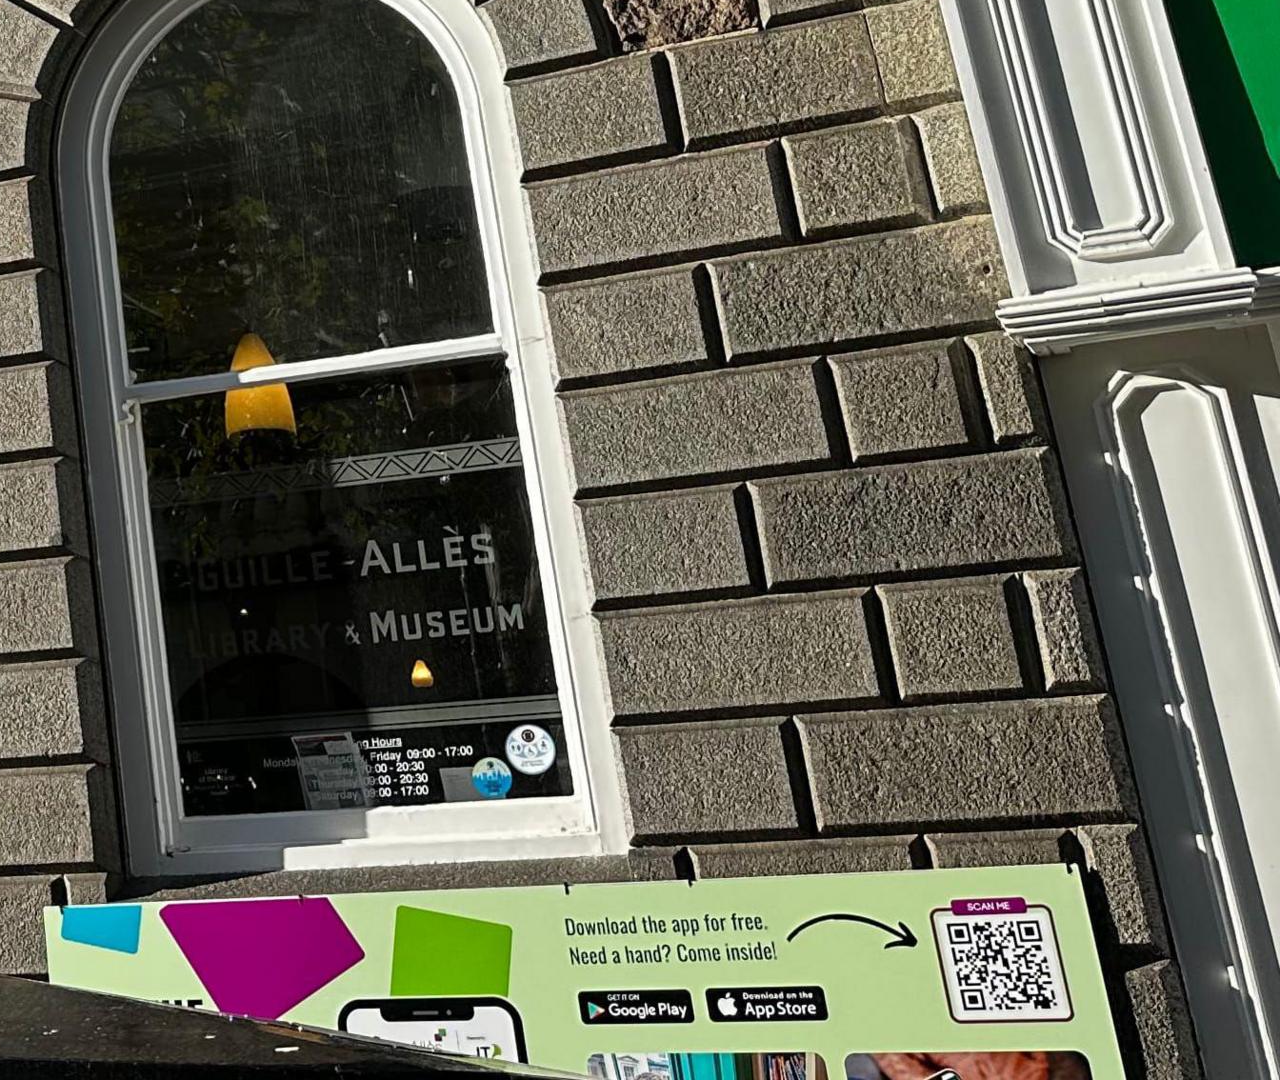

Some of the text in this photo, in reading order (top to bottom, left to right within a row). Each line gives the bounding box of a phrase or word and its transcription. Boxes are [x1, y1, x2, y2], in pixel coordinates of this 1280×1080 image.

[344, 618, 362, 646] &
[369, 603, 525, 644] MUSEUM
[372, 737, 402, 748] Hours
[370, 751, 401, 762] Friday
[406, 748, 435, 759] 09:00
[444, 745, 474, 757] 17:00
[396, 761, 425, 772] 20:30
[399, 772, 429, 784] 20:30
[400, 784, 429, 796] 17:00
[967, 901, 1011, 911] SCAN ME
[564, 912, 768, 937] Download the app for free.
[569, 941, 778, 965] Need a hand? Come inside!
[742, 992, 784, 1000] Download
[798, 991, 813, 999] the
[608, 1002, 687, 1019] Google Play
[745, 1001, 817, 1019] App Store
